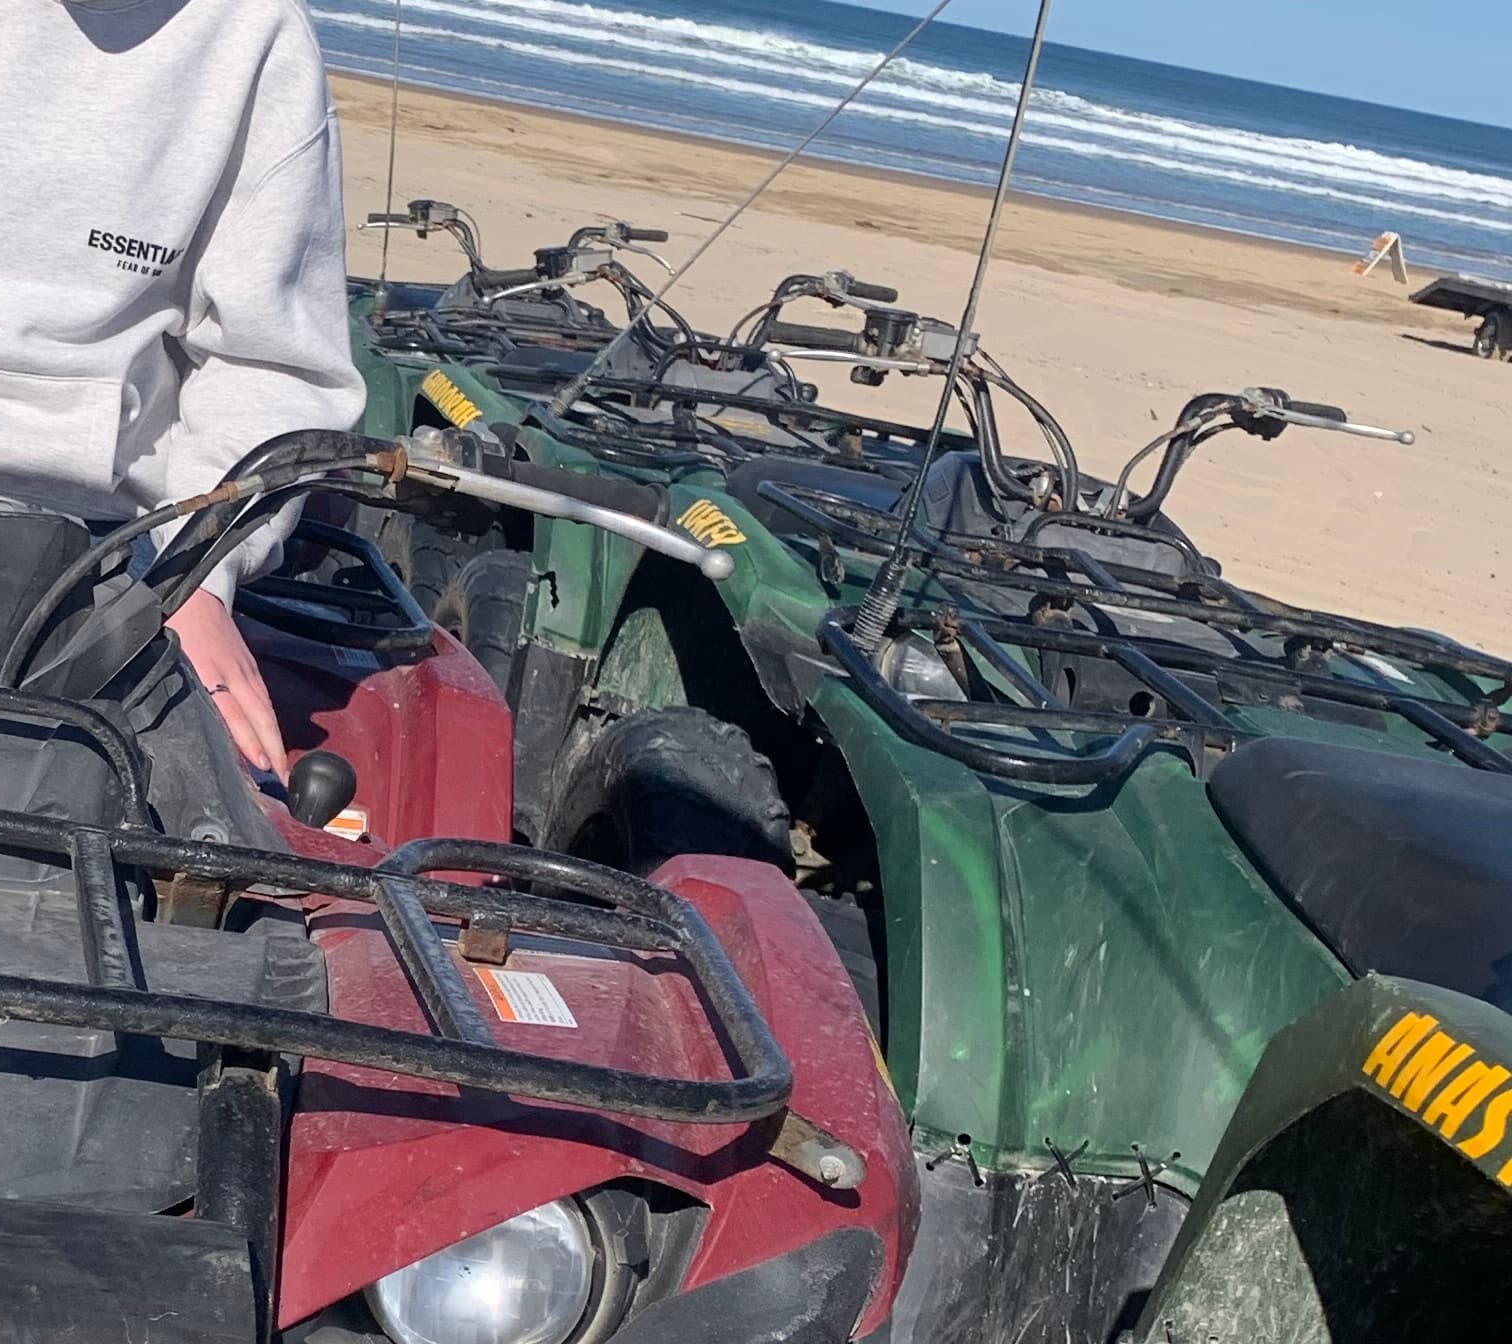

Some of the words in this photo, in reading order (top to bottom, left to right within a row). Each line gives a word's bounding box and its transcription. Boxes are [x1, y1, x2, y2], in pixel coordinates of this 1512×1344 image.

[88, 228, 184, 266] ESSENTIA
[117, 259, 139, 273] FEAR
[141, 265, 151, 275] OF
